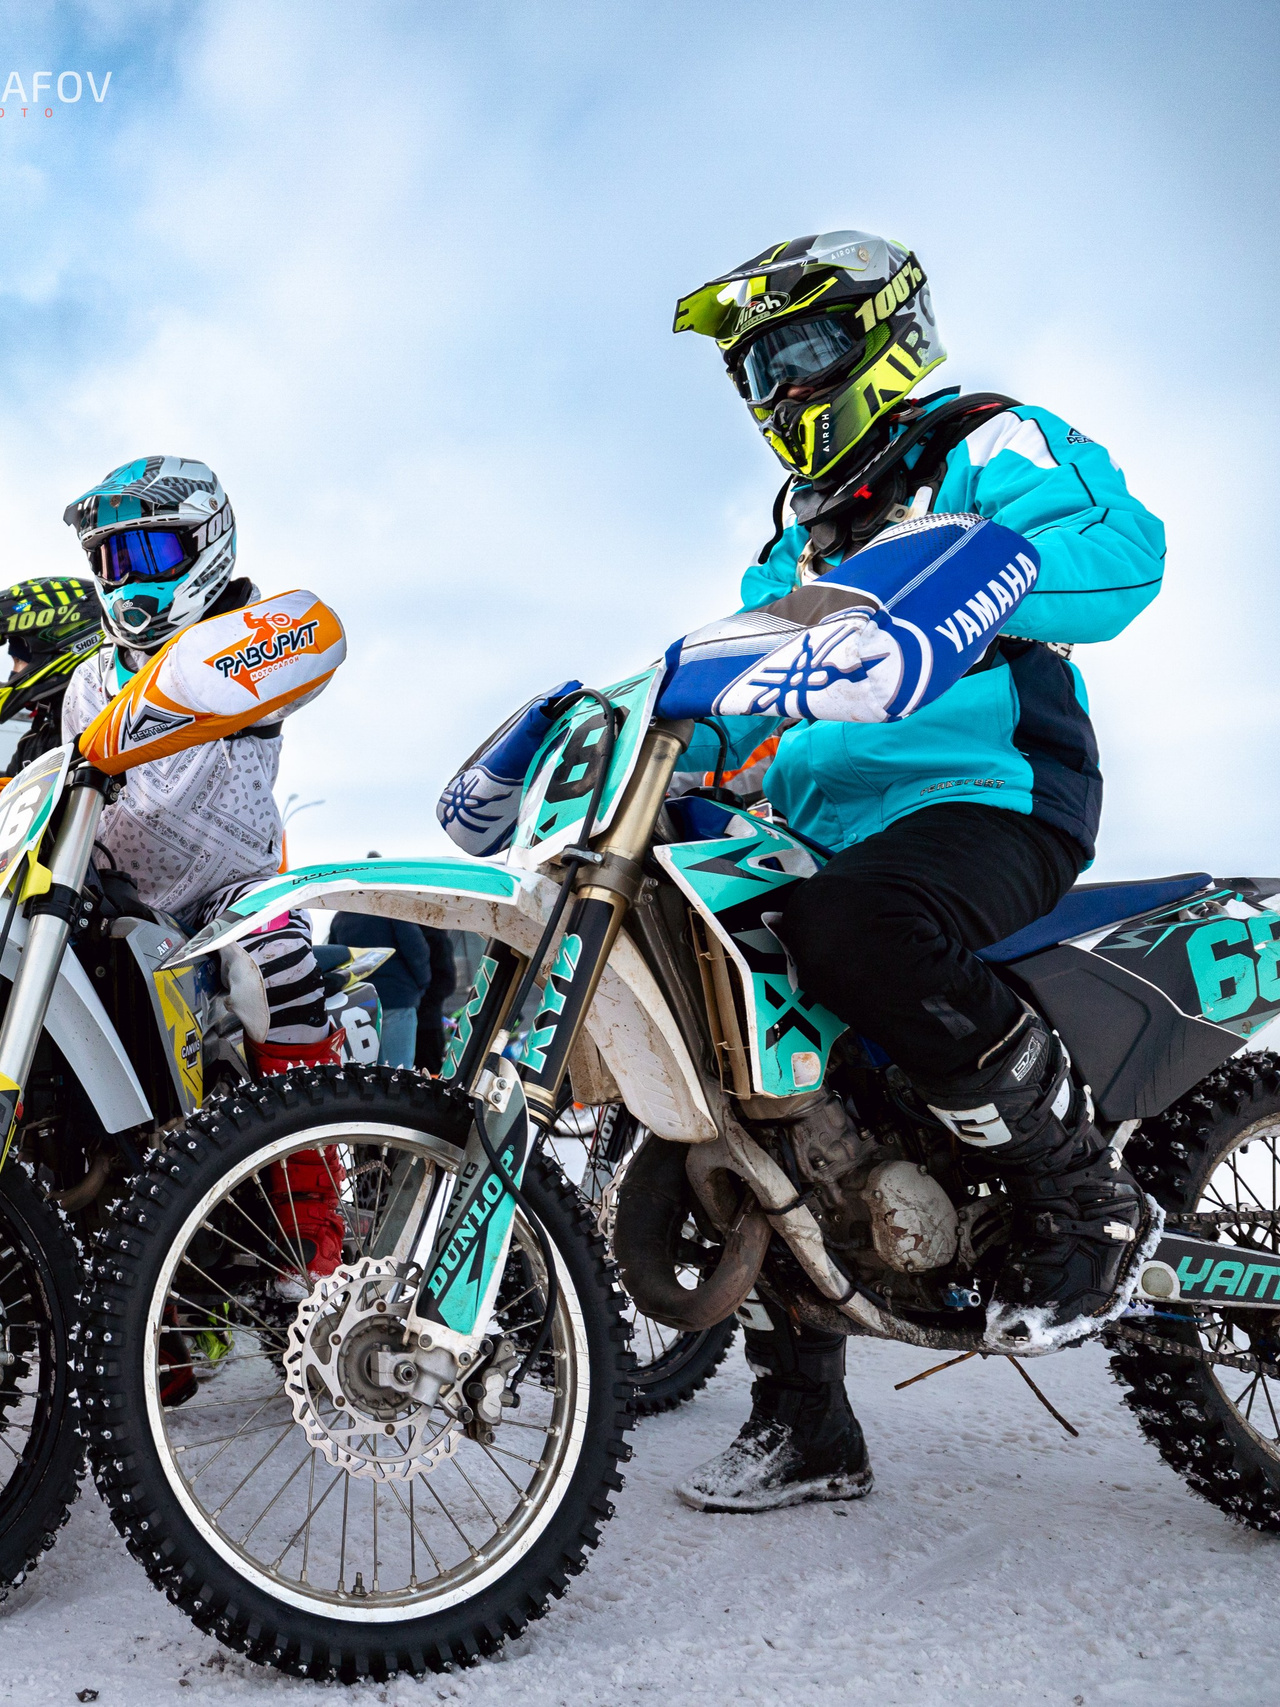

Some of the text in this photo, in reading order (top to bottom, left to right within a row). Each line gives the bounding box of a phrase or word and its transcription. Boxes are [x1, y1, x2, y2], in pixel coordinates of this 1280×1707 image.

[831, 246, 856, 261] AIROH
[734, 294, 781, 332] Airoh
[855, 262, 922, 333] 100%
[822, 413, 830, 452] AIROH
[6, 604, 80, 633] 100%
[935, 553, 1037, 653] YAMAHA
[75, 636, 98, 652] SHOEI
[215, 621, 318, 678] ФАВОРИТ
[251, 656, 299, 680] МОТОСАЛОН
[427, 1149, 515, 1299] DUNLOP
